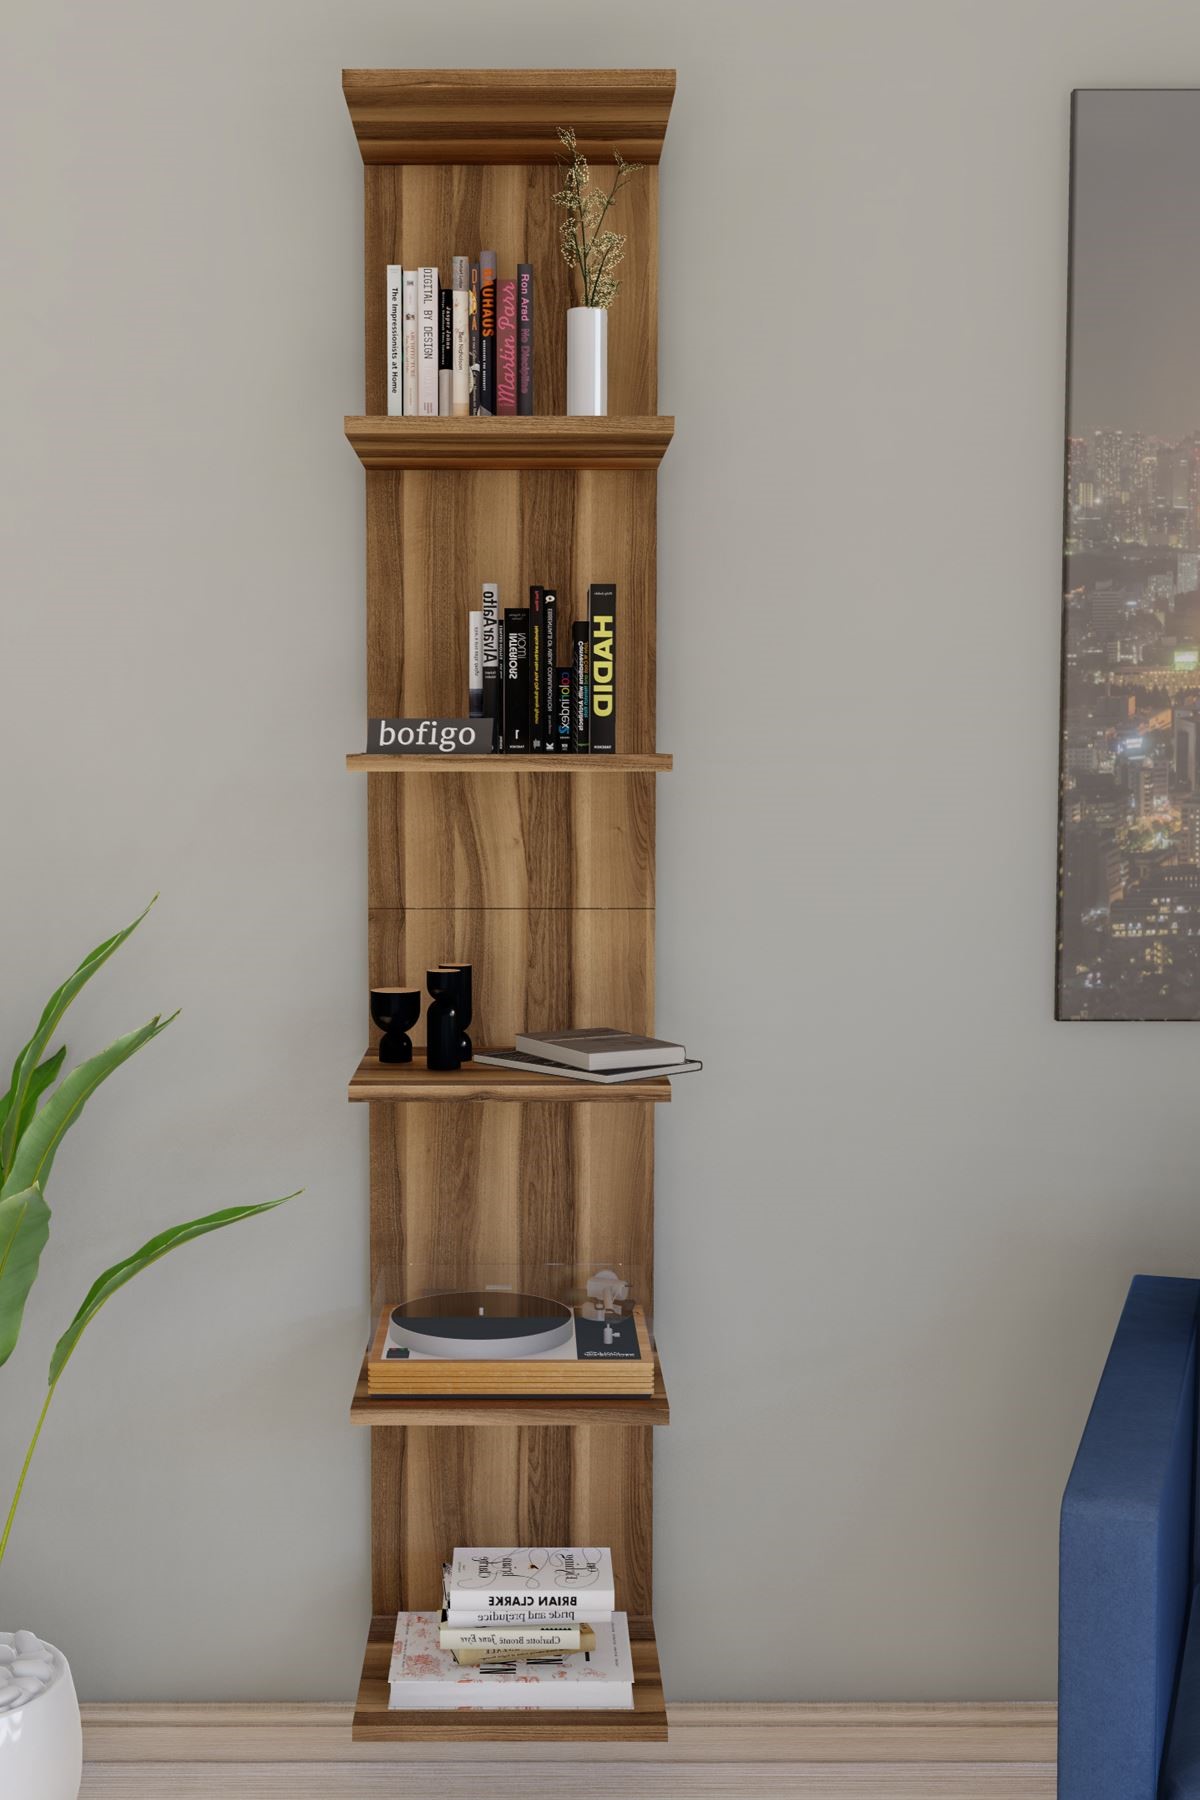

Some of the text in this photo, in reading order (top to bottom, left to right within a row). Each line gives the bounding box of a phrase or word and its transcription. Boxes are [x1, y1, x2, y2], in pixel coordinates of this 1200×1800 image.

[424, 269, 432, 359] DIGITAL BY DESIGN
[482, 268, 494, 337] BAUHAUS
[499, 282, 515, 406] Martin Parr
[520, 274, 529, 394] Ron Arad No Discipline
[380, 720, 476, 752] bofigo
